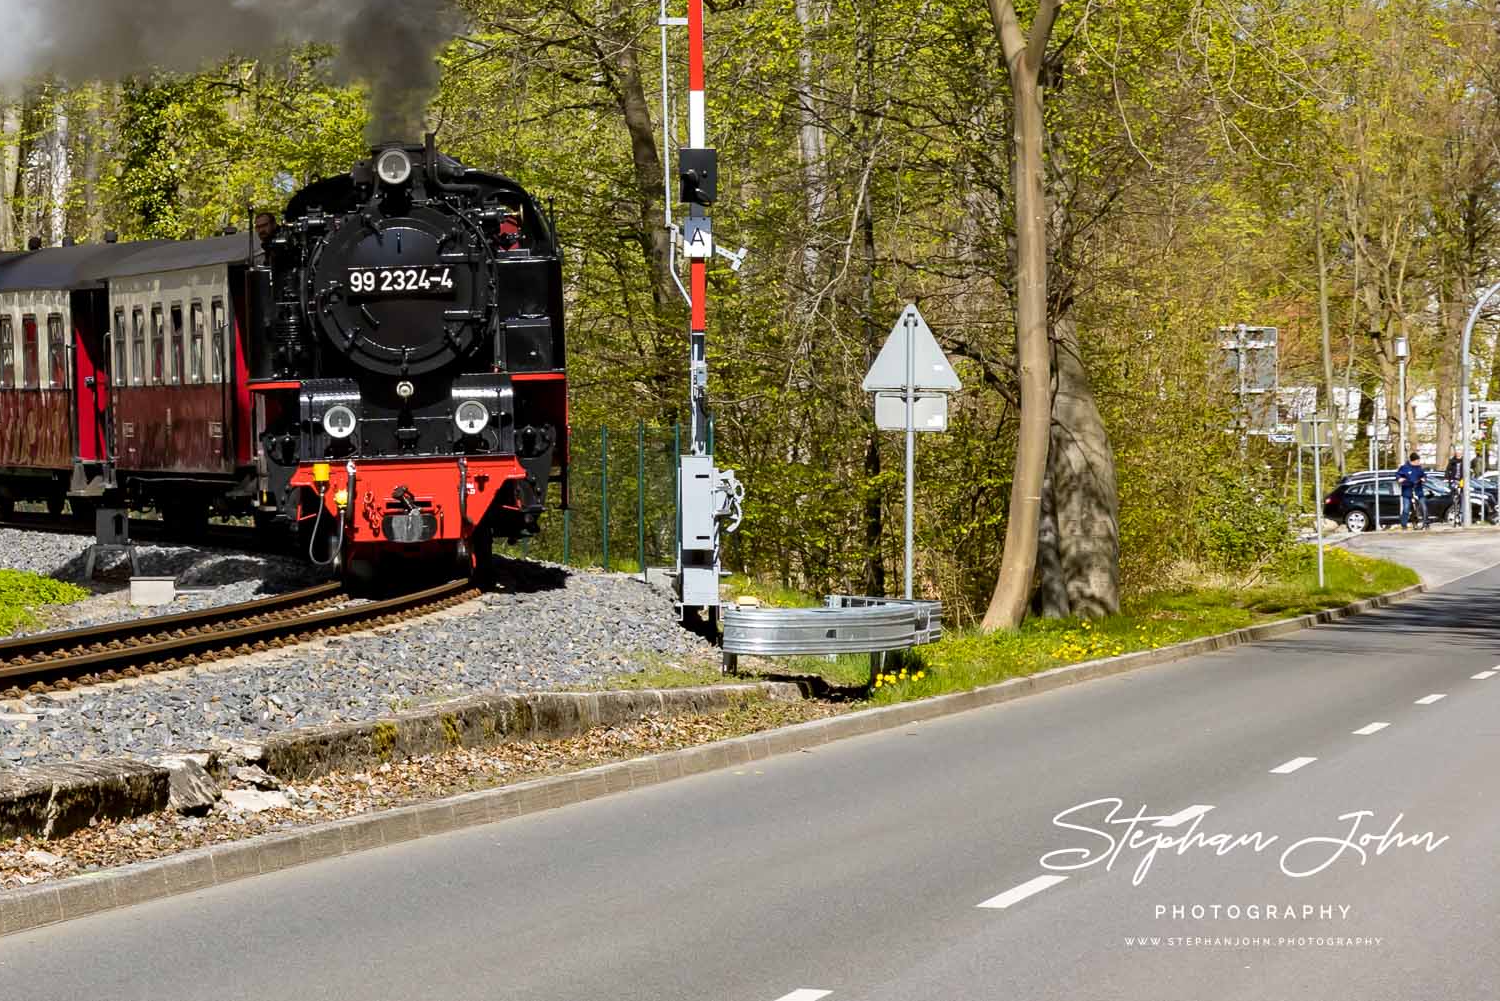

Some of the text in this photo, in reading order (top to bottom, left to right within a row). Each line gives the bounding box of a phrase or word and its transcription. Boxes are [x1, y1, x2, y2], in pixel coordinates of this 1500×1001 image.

[691, 227, 705, 246] A
[350, 268, 453, 292] 99 2324-4
